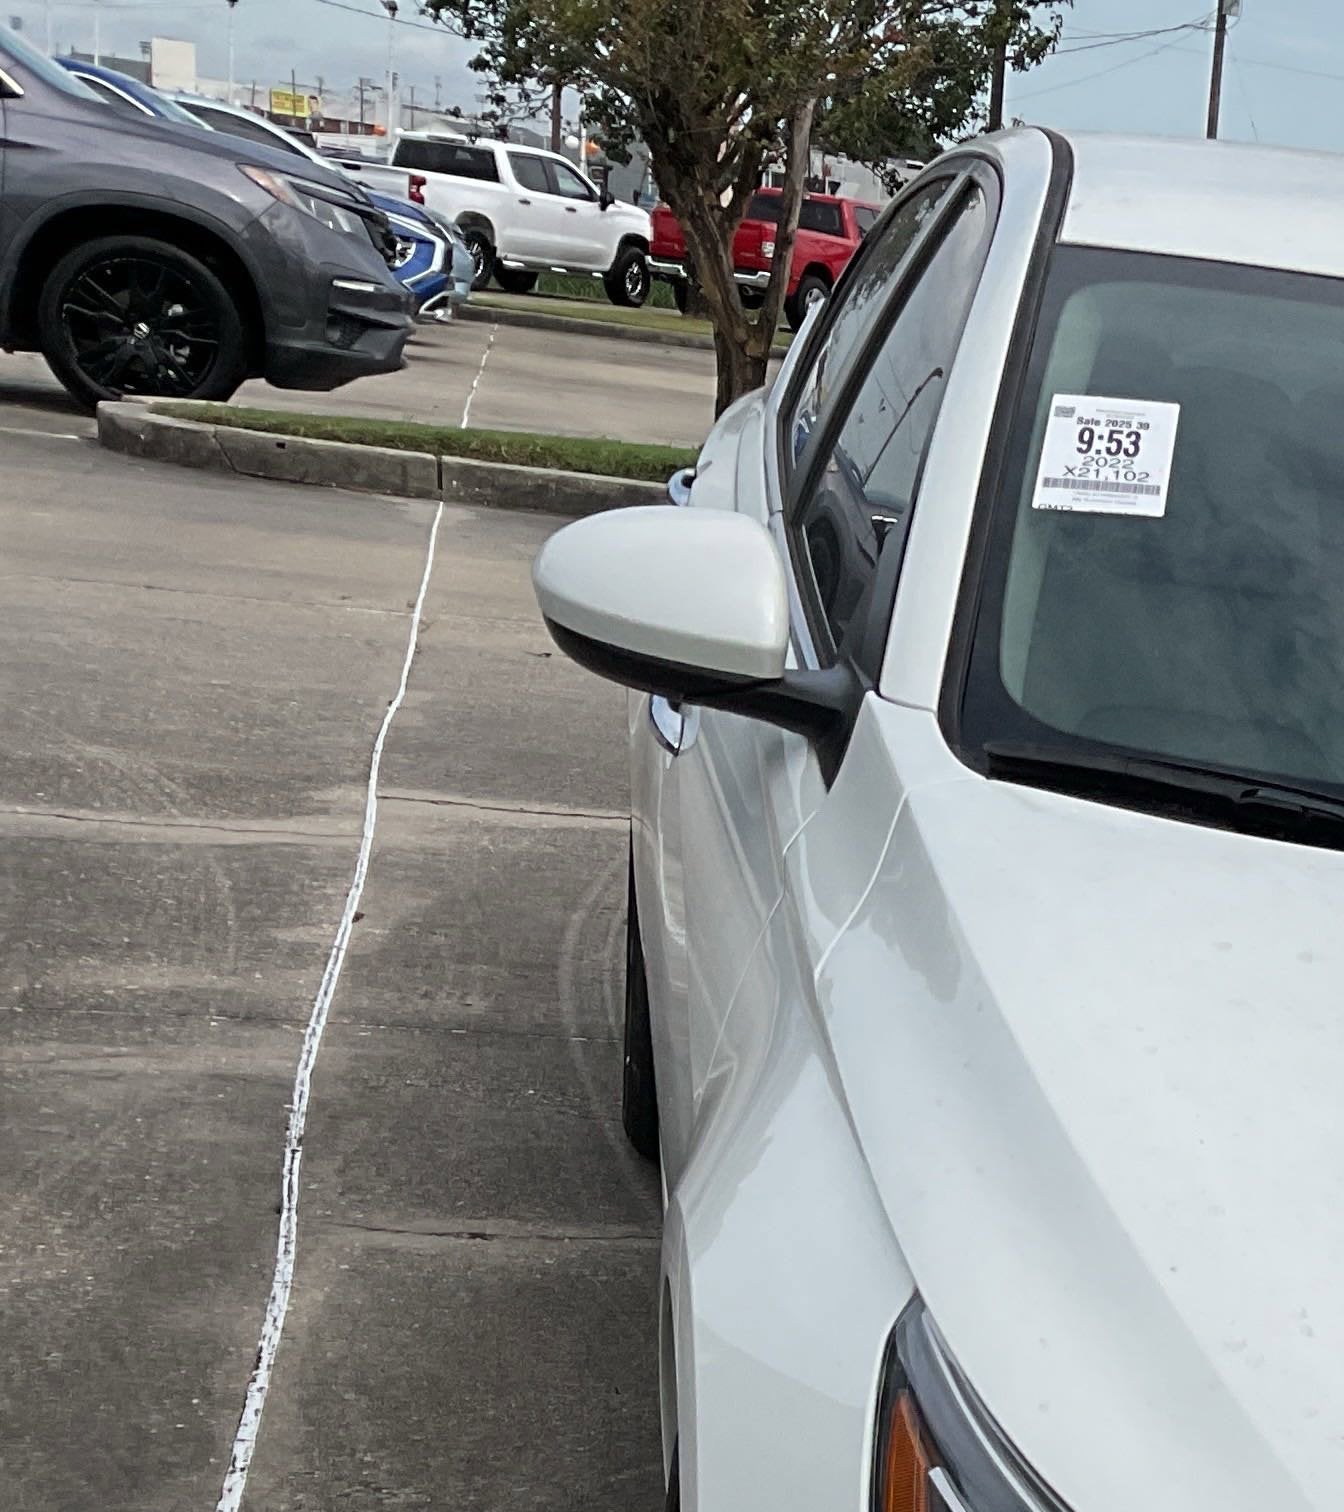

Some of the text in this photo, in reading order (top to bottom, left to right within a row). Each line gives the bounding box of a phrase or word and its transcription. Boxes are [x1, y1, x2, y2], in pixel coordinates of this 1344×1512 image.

[1076, 416, 1101, 427] Sale
[1105, 418, 1132, 429] 2025
[1076, 426, 1142, 458] 9:53
[1081, 455, 1135, 470] 2022
